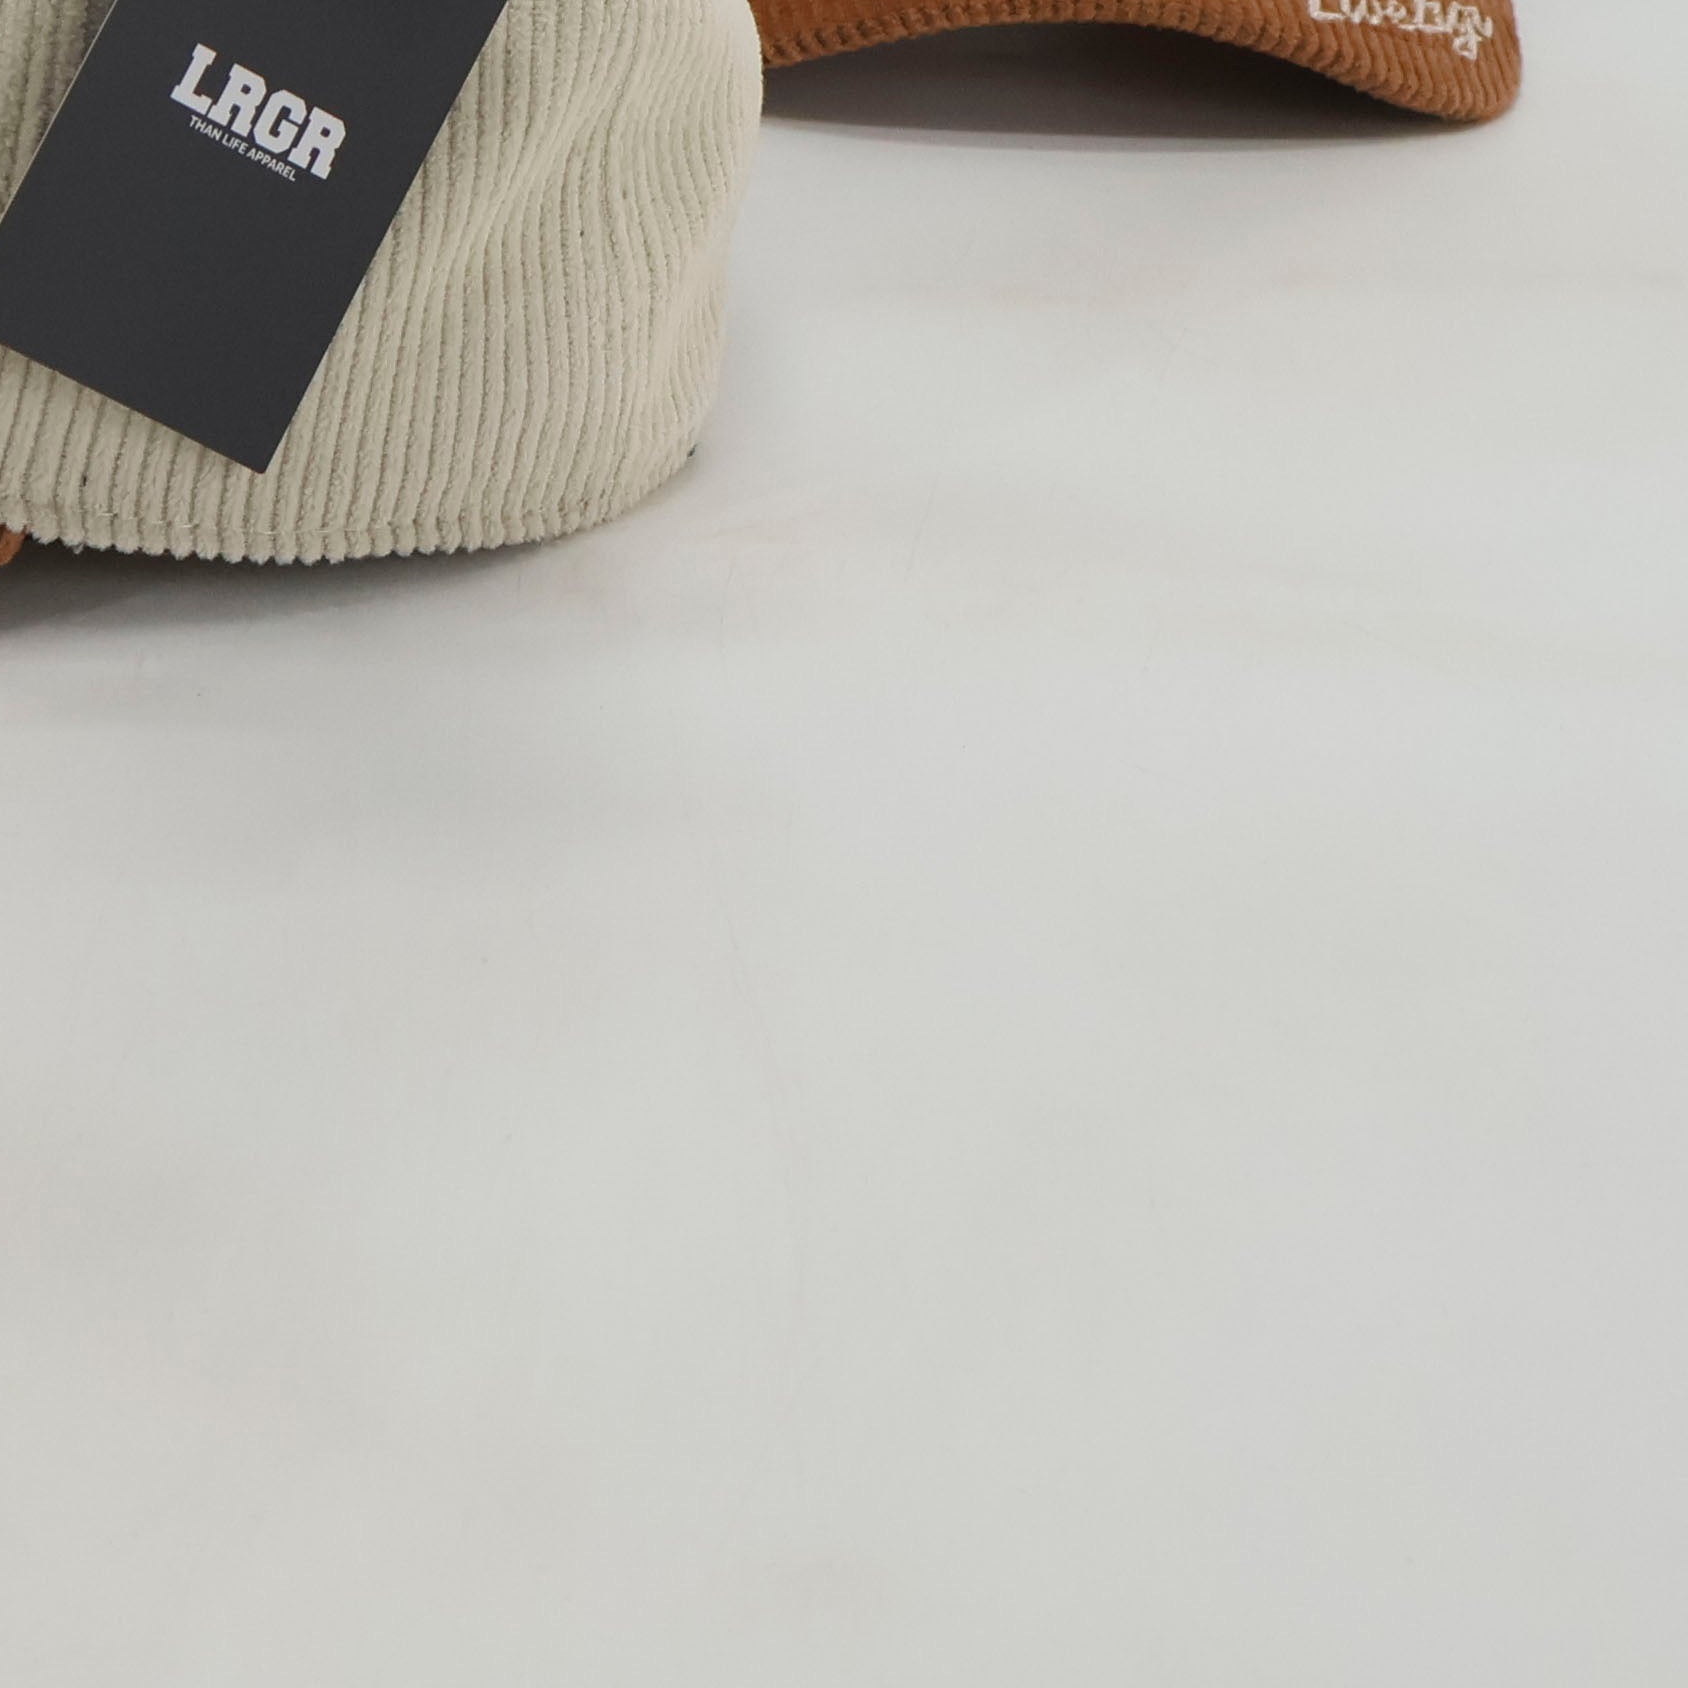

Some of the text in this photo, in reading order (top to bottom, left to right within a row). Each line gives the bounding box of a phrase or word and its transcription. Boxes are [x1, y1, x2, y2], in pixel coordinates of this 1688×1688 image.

[170, 43, 347, 180] LRGR
[189, 115, 297, 182] THAN LIFE APPAREL
